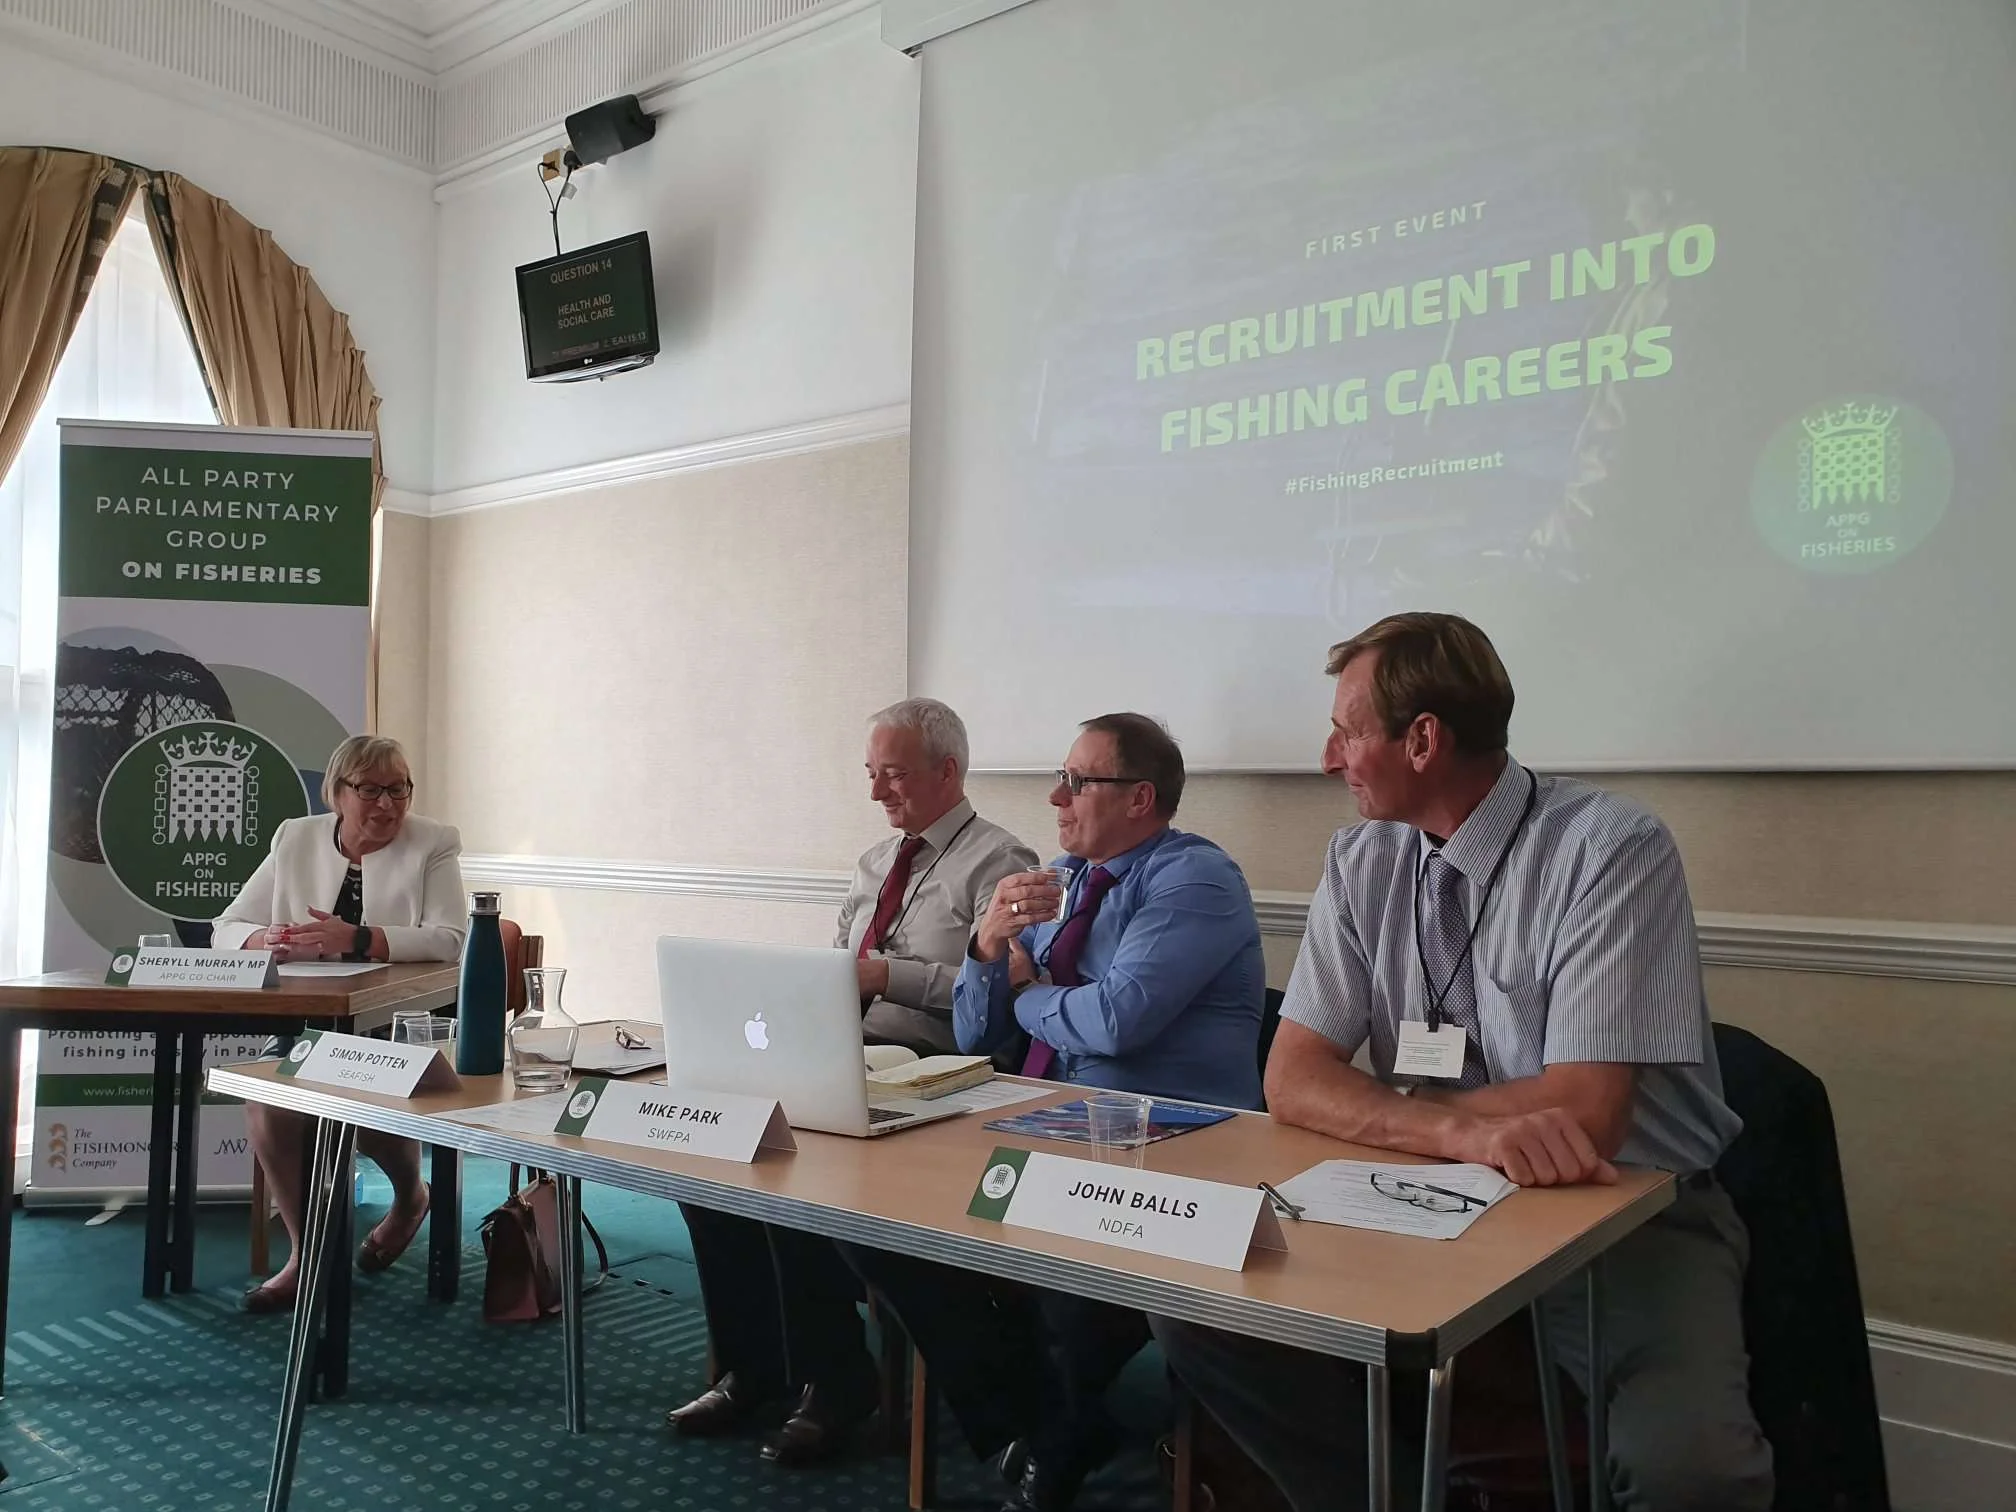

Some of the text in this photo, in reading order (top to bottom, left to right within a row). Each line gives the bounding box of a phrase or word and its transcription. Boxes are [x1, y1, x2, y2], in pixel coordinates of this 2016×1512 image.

[1305, 201, 1486, 259] FIRST EVENT
[550, 257, 612, 284] QUESTION 14
[558, 293, 612, 315] HEALTH AND
[1136, 223, 1716, 380] RECRUITMENT INTO
[558, 306, 615, 329] SOCIAL CARE
[1161, 325, 1673, 452] FISHING CAREERS
[141, 467, 294, 490] ALL PARTY
[1284, 450, 1504, 495] #FishingRecruitment
[96, 496, 339, 522] PARLIAMENTARY
[1826, 512, 1870, 527] APPG
[166, 530, 267, 550] GROUP
[1802, 536, 1897, 558] FISHERIES
[122, 561, 321, 584] ON FISHERIES
[181, 852, 227, 866] APPG
[194, 868, 214, 879] ON
[139, 956, 266, 969] SHERYLL MURRAY MP
[160, 973, 187, 981] APPG
[207, 974, 238, 983] CHAIR
[63, 1046, 125, 1060] fishing
[214, 1045, 230, 1057] in
[330, 1047, 409, 1070] SIMON POTTEN
[337, 1068, 376, 1083] SEAFISH
[638, 1101, 723, 1125] MIKE PARK
[74, 1128, 92, 1139] The
[647, 1127, 691, 1144] SWFPA
[72, 1158, 118, 1170] Company
[1068, 1181, 1199, 1219] JOHN BALLS
[1098, 1217, 1145, 1239] NDFA
